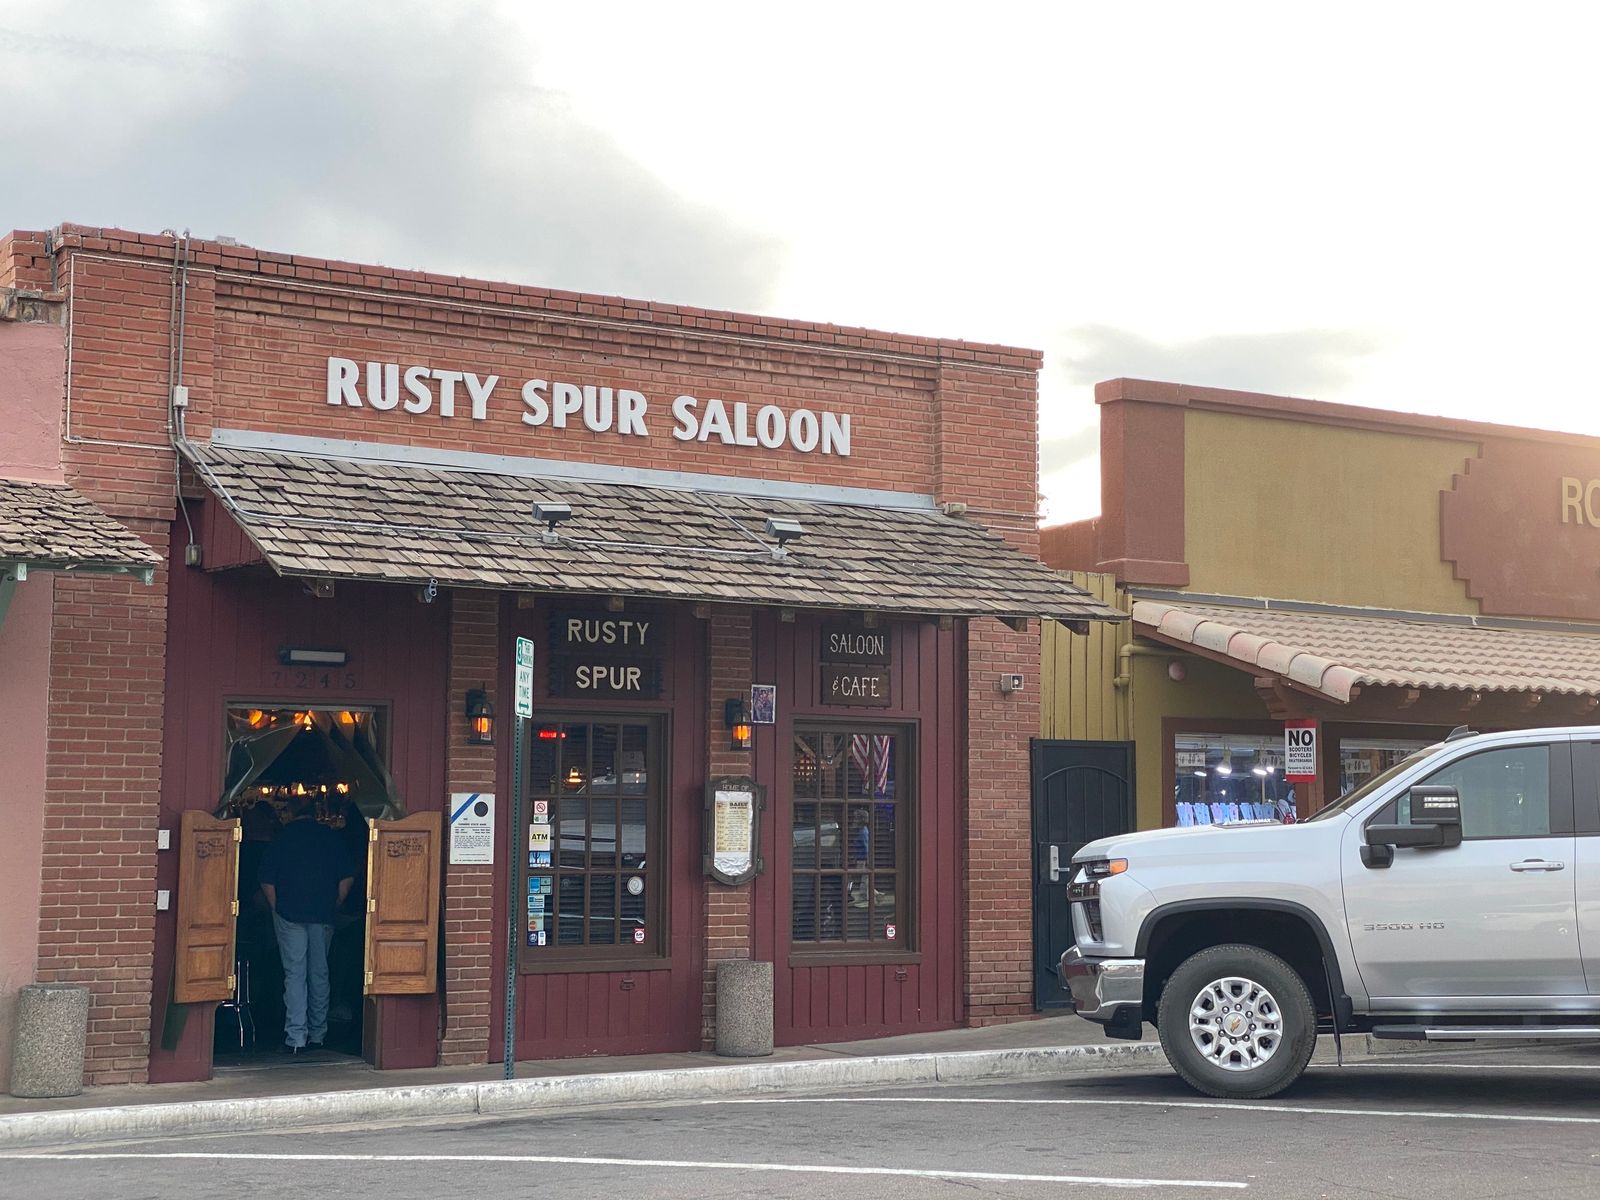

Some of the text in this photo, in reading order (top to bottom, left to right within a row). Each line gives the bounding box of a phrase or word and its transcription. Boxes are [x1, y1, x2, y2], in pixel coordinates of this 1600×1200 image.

[327, 356, 850, 456] RUSTY SPUR SALOON
[567, 618, 649, 645] RUSTY
[830, 633, 884, 655] SALOON
[518, 671, 530, 684] ANY
[576, 665, 641, 691] SPUR
[841, 676, 880, 697] CAFE
[518, 685, 530, 700] TIME
[1288, 730, 1313, 746] NO
